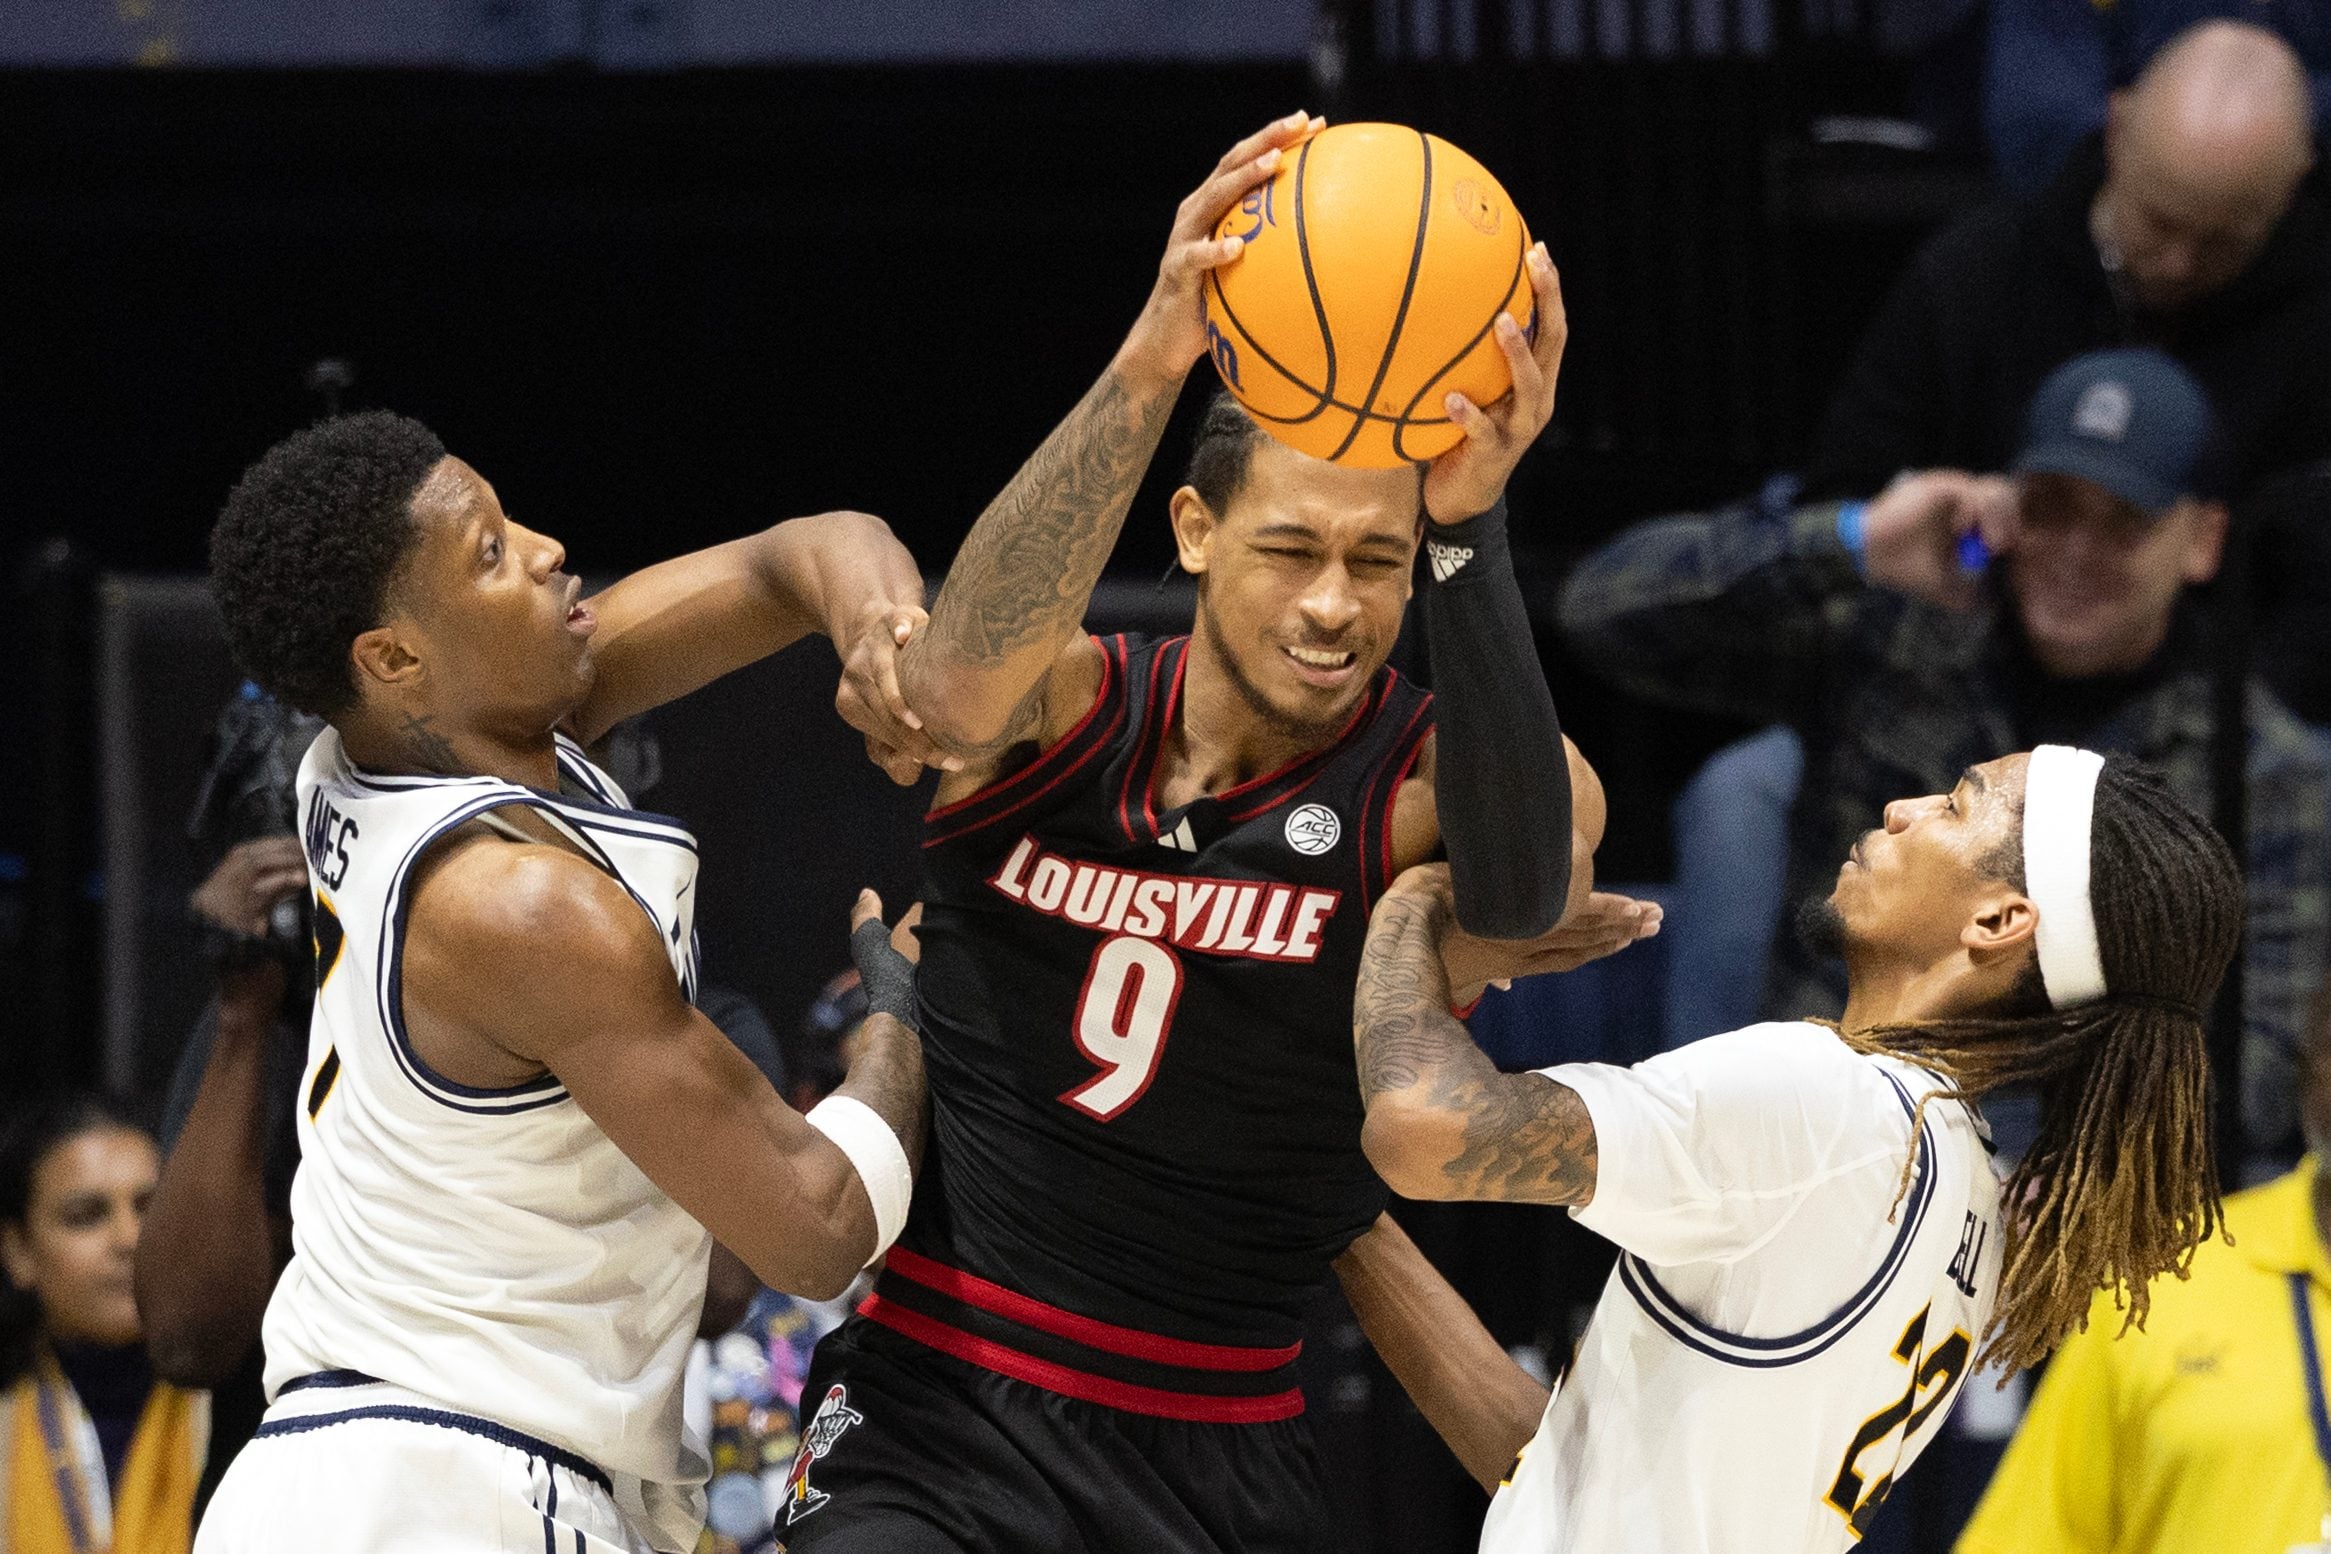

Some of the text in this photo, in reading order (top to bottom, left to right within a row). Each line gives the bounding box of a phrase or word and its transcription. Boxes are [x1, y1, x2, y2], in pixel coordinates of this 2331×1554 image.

[1293, 820, 1336, 835] ACC
[986, 833, 1342, 963] LOUISVILLE
[1057, 934, 1184, 1123] 9
